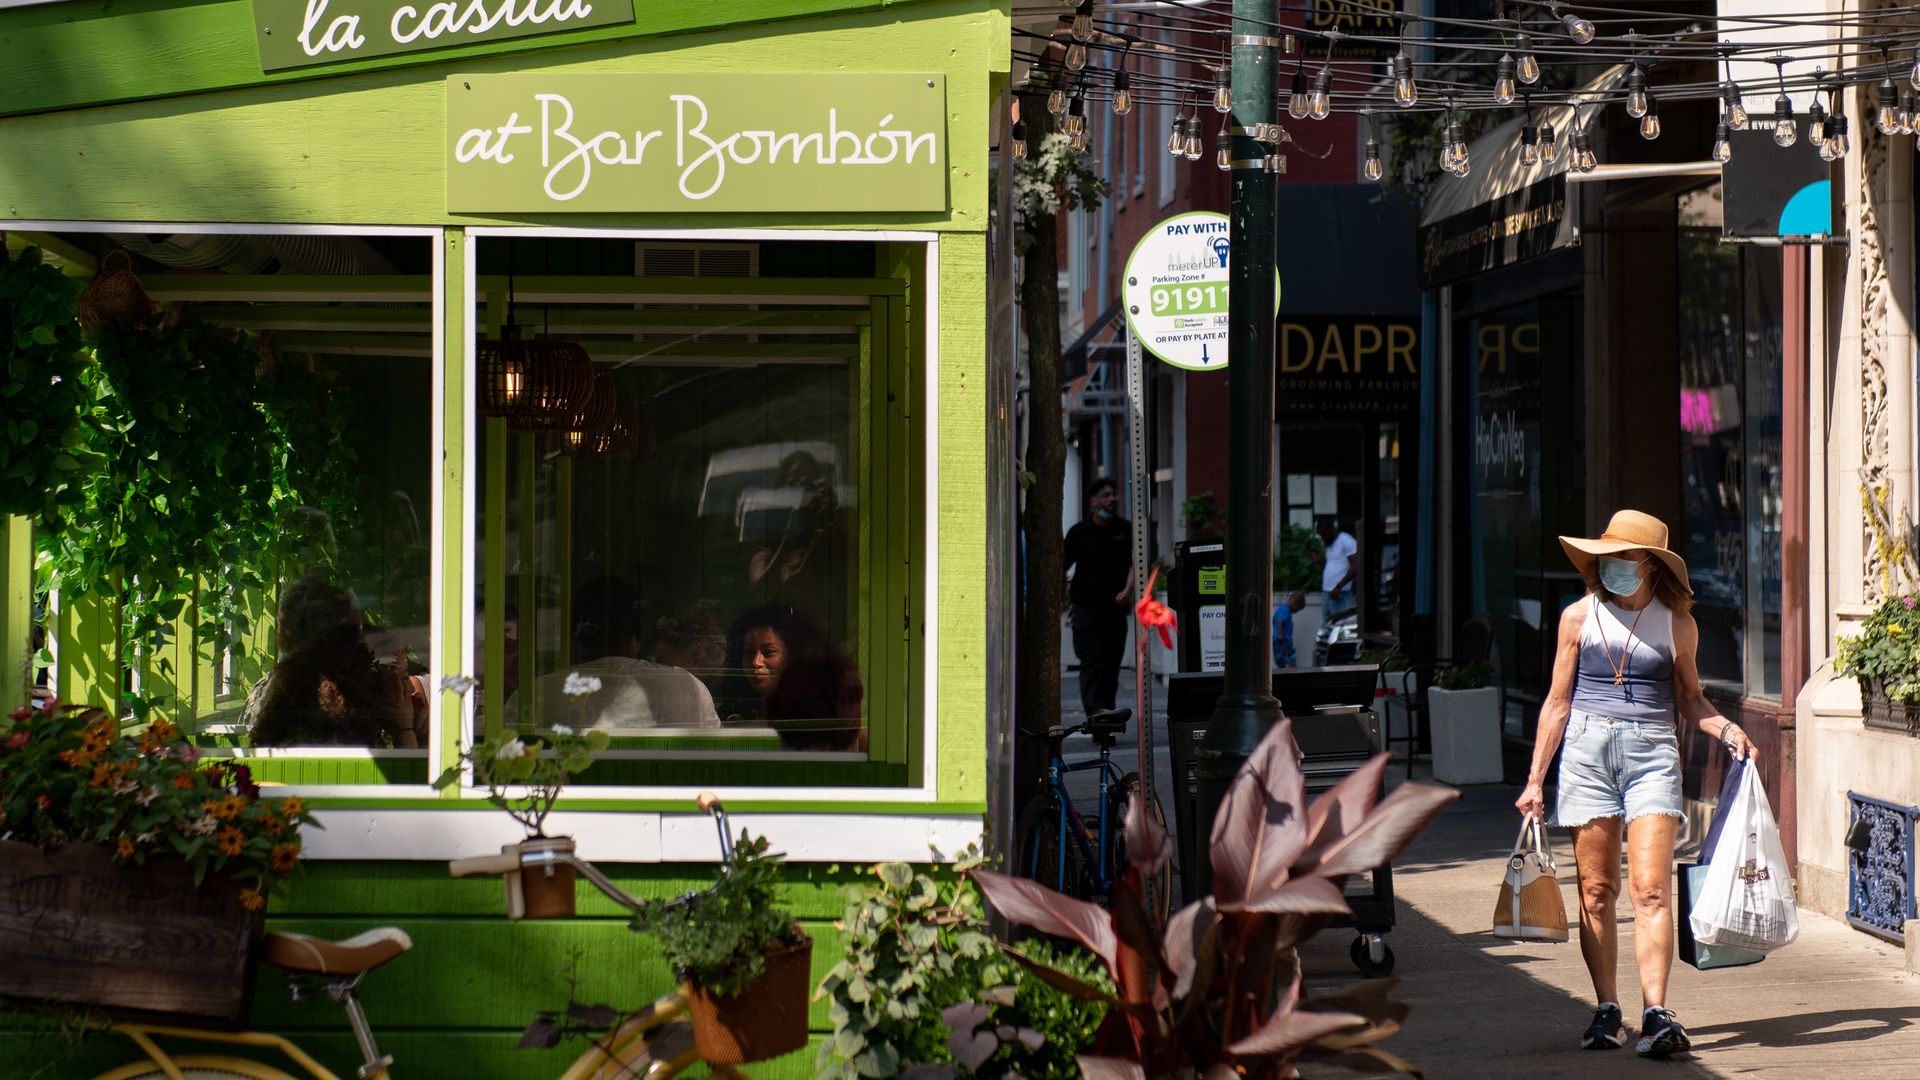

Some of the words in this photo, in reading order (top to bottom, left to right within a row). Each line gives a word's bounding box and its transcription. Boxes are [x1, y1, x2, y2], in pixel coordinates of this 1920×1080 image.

[1313, 0, 1395, 27] DAPR
[297, 0, 366, 56] la
[1752, 120, 1796, 130] EYEW
[455, 112, 533, 164] at
[534, 93, 663, 200] Bar
[669, 94, 937, 200] Bombón
[1167, 224, 1190, 236] PAY
[1193, 222, 1227, 234] WITH
[1168, 256, 1219, 272] meterUP
[1152, 275, 1180, 285] Parking
[1181, 274, 1200, 282] Zone
[1155, 336, 1167, 344] OR
[1168, 335, 1181, 343] PAY
[1183, 334, 1193, 342] BY
[1194, 332, 1217, 341] PLATE
[1217, 332, 1227, 340] AT
[1281, 323, 1417, 374] DAPR
[1279, 379, 1353, 390] GROOMING
[1359, 379, 1419, 391] PARLOUR
[1475, 409, 1525, 480] HipCityVeg
